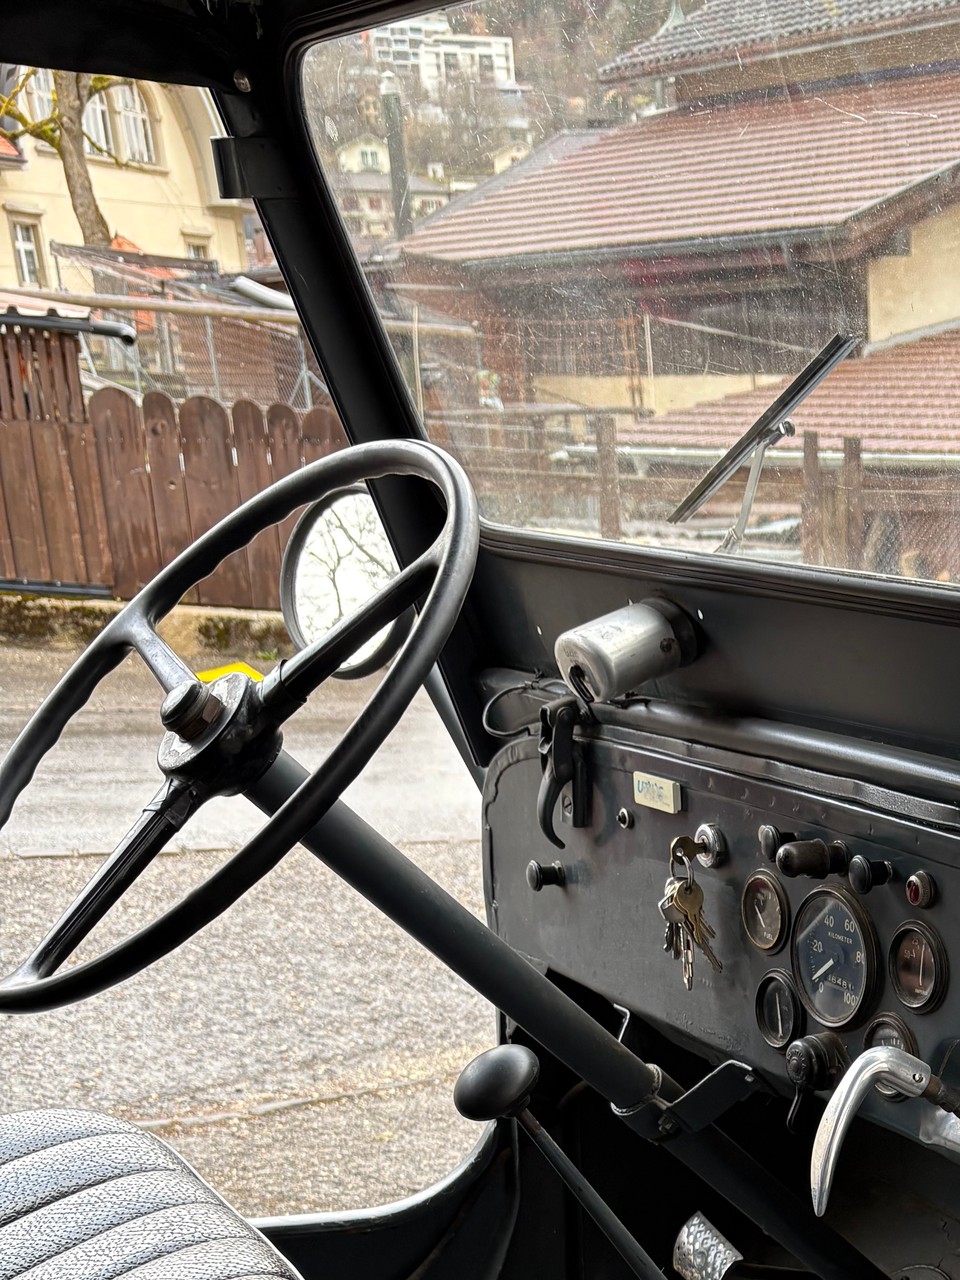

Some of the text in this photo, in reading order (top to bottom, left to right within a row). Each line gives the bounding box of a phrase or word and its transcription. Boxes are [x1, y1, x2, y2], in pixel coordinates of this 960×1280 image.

[825, 916, 834, 927] 40
[845, 920, 855, 932] 60
[828, 932, 852, 944] KILOMETER
[813, 940, 823, 952] 20
